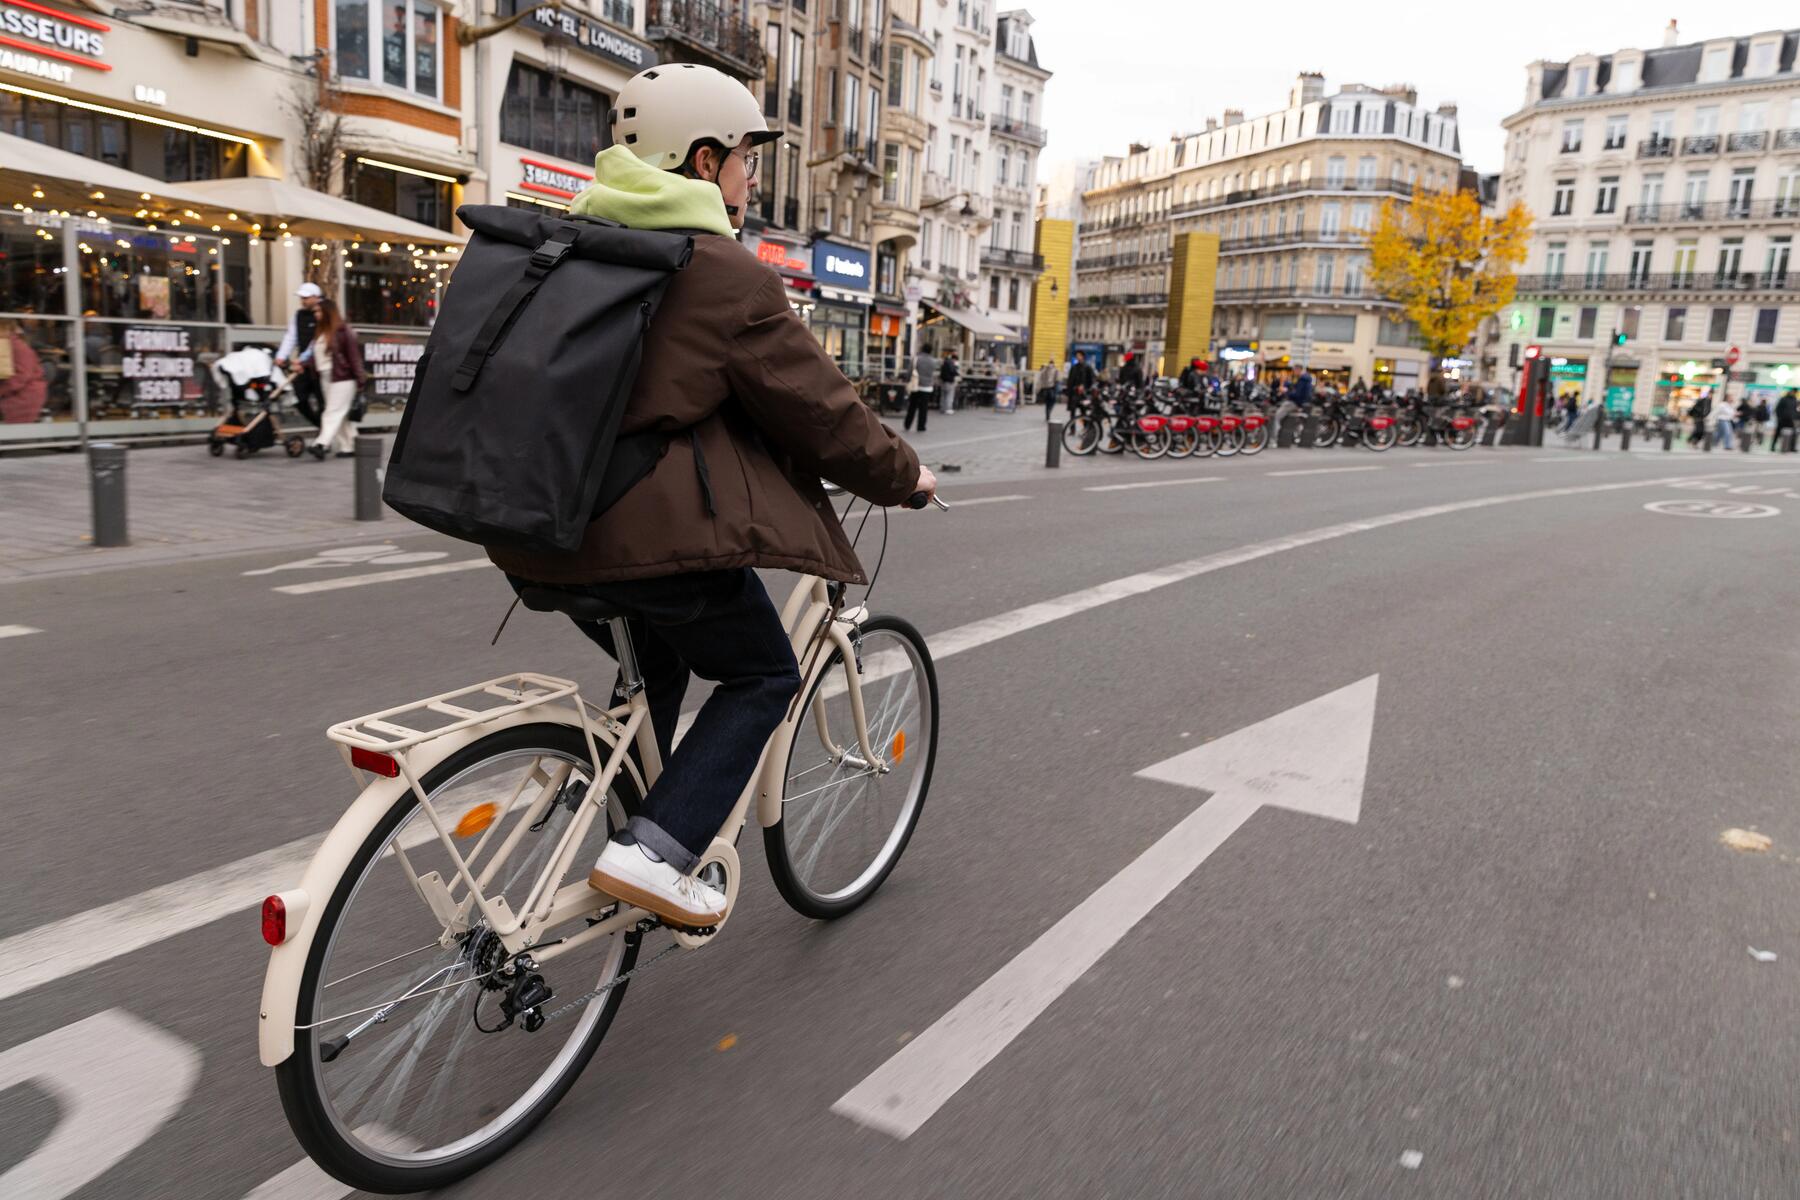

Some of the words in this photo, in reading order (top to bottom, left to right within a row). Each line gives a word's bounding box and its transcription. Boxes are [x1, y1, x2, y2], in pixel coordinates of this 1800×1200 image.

[590, 28, 642, 65] LONDRES
[134, 84, 167, 106] BAR
[524, 164, 534, 183] 3
[125, 330, 191, 351] FORMULE
[364, 343, 399, 362] HAPPY
[122, 352, 195, 377] DÉJEUNER
